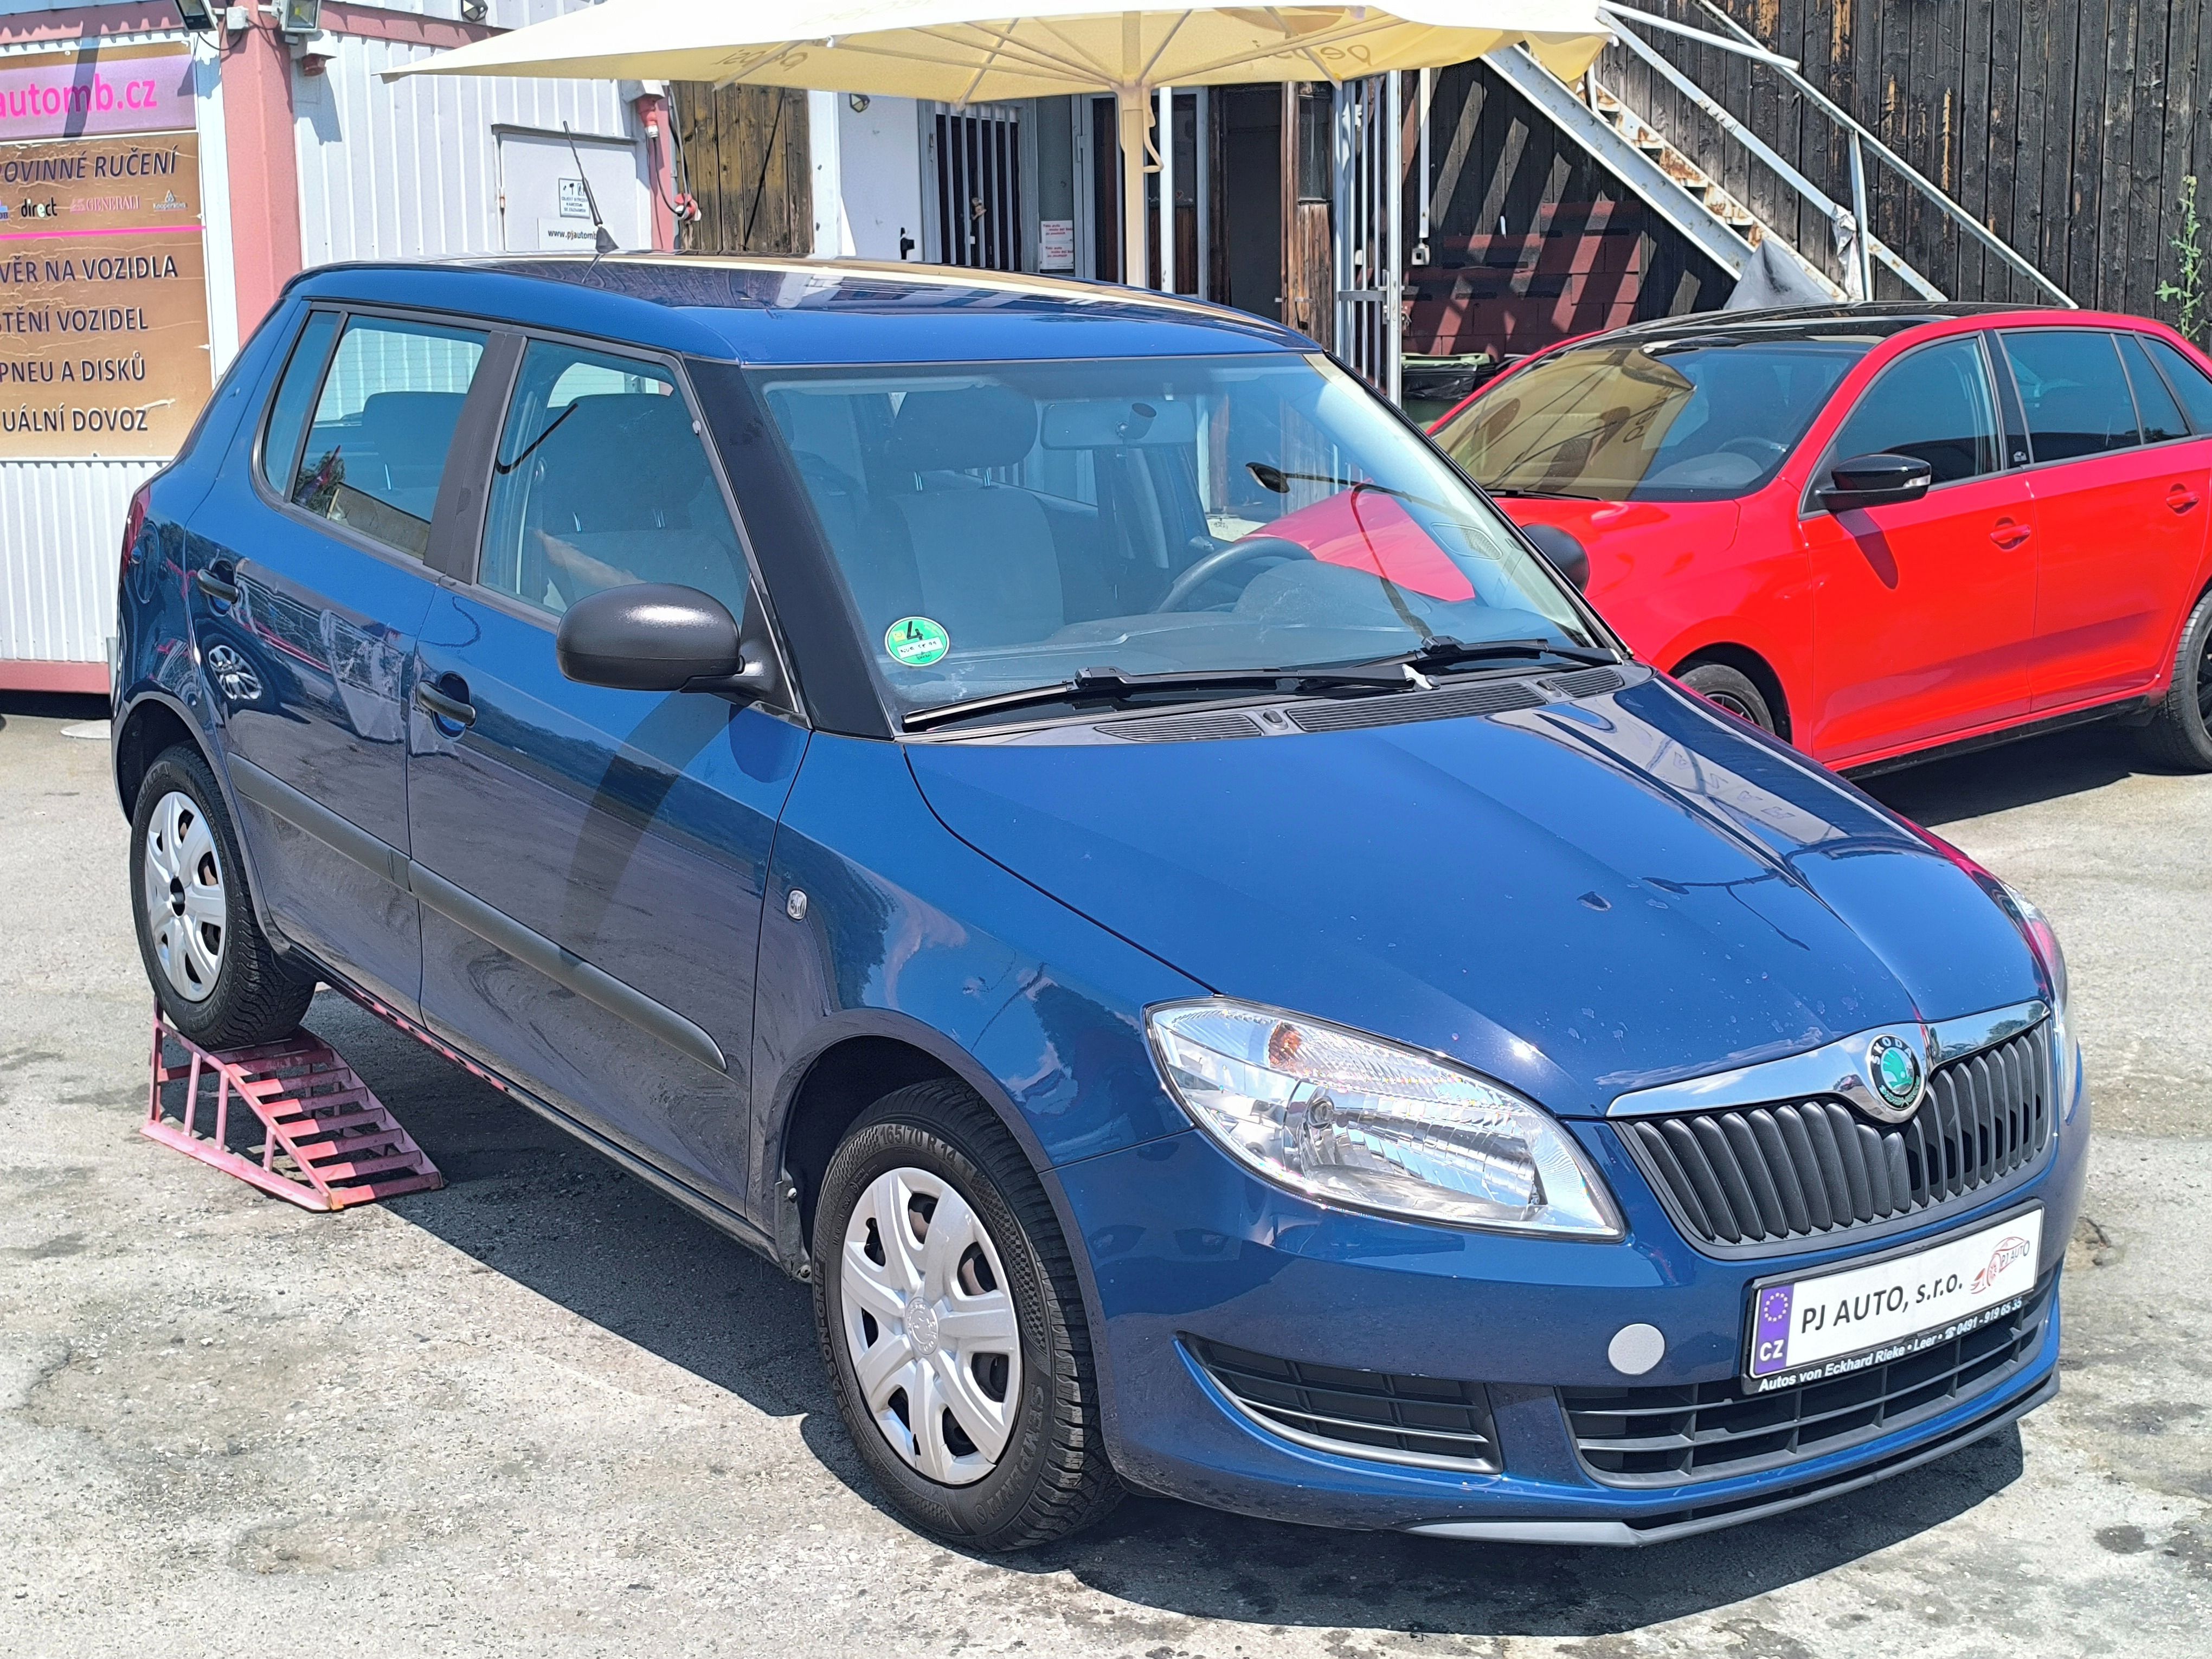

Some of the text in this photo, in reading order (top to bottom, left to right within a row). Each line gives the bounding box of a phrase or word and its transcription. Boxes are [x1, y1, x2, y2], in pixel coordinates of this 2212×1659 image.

[0, 145, 178, 183] OVINNÉ RUČENÍ
[21, 197, 57, 218] direct
[87, 196, 140, 211] GENERALI
[0, 255, 178, 283] VĚR NA VOZIDLA
[0, 305, 148, 332] TĚNÍ VOZIDEL
[0, 351, 145, 382] PNEU A DISKŮ
[72, 409, 148, 432] DOVOZ
[906, 621, 923, 640] 4
[880, 1124, 923, 1147] 165/70
[927, 1133, 942, 1155] R
[941, 1143, 957, 1166] 14
[2010, 1240, 2030, 1261] AUTO
[1802, 1274, 1963, 1334] PJ AUTO, s.r.o.
[1758, 1375, 1796, 1392] Autos
[1799, 1368, 1822, 1382] von
[1824, 1353, 1874, 1377] Eckhard
[1875, 1345, 1905, 1364] Rieke
[1914, 1335, 1937, 1352] Leer
[1957, 1316, 1978, 1335] 0491
[1984, 1307, 1999, 1323] 919
[2001, 1302, 2011, 1316] 65
[1759, 1339, 1784, 1362] CZ
[987, 1384, 1044, 1518] SEMPERIT
